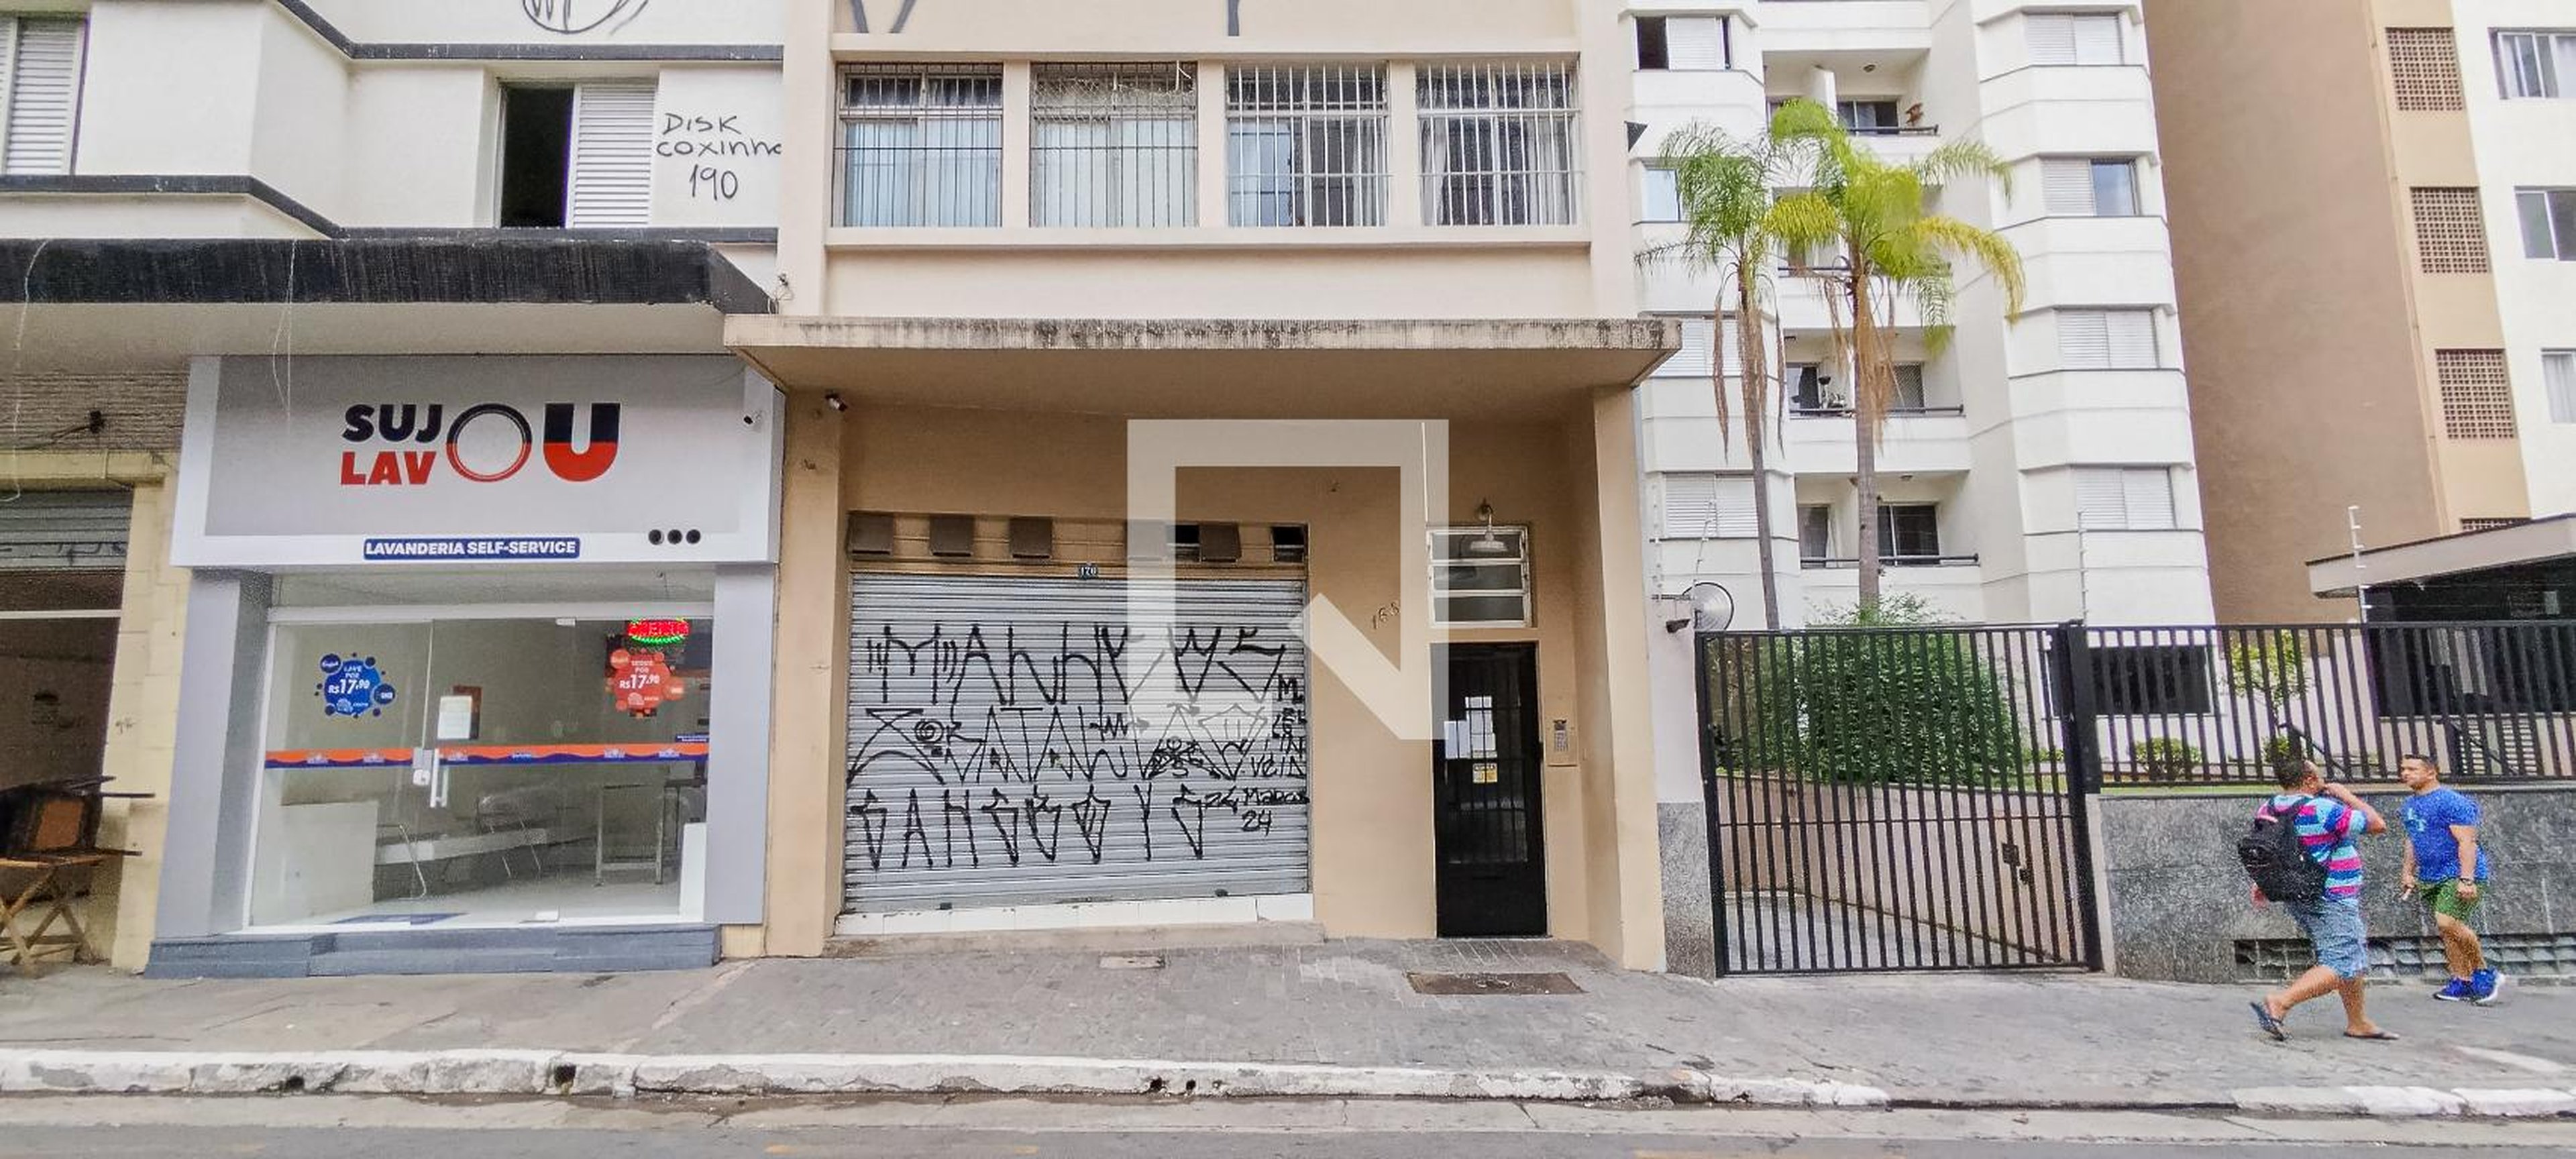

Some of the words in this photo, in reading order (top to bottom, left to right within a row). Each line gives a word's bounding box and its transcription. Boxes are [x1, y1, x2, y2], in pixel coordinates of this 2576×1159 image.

[663, 113, 742, 135] DISK
[689, 164, 739, 201] 190
[366, 542, 466, 555] LAVANDERIA
[467, 541, 576, 555] SELF-SERVICE
[1242, 809, 1273, 838] 24
